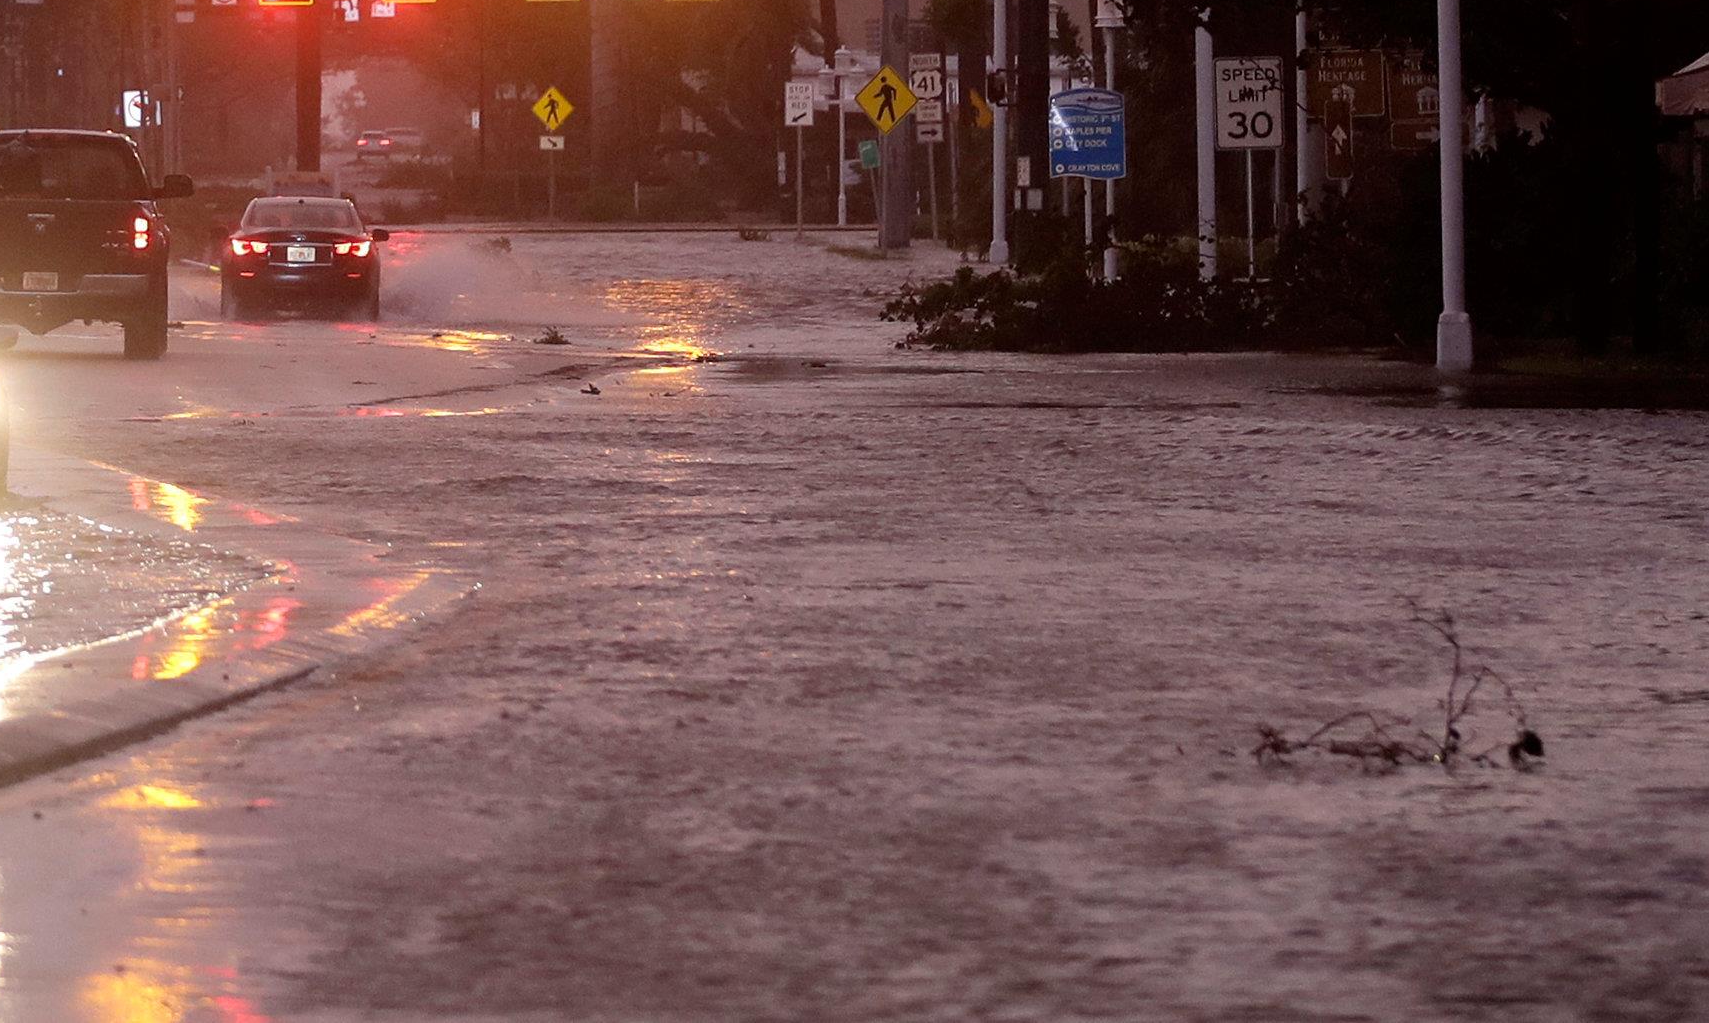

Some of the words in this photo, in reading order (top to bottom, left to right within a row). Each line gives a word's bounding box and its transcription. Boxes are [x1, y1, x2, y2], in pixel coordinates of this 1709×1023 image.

[1222, 68, 1275, 82] SPEED
[917, 75, 935, 92] 41
[1228, 88, 1268, 103] LIMIT
[1228, 111, 1273, 139] 30
